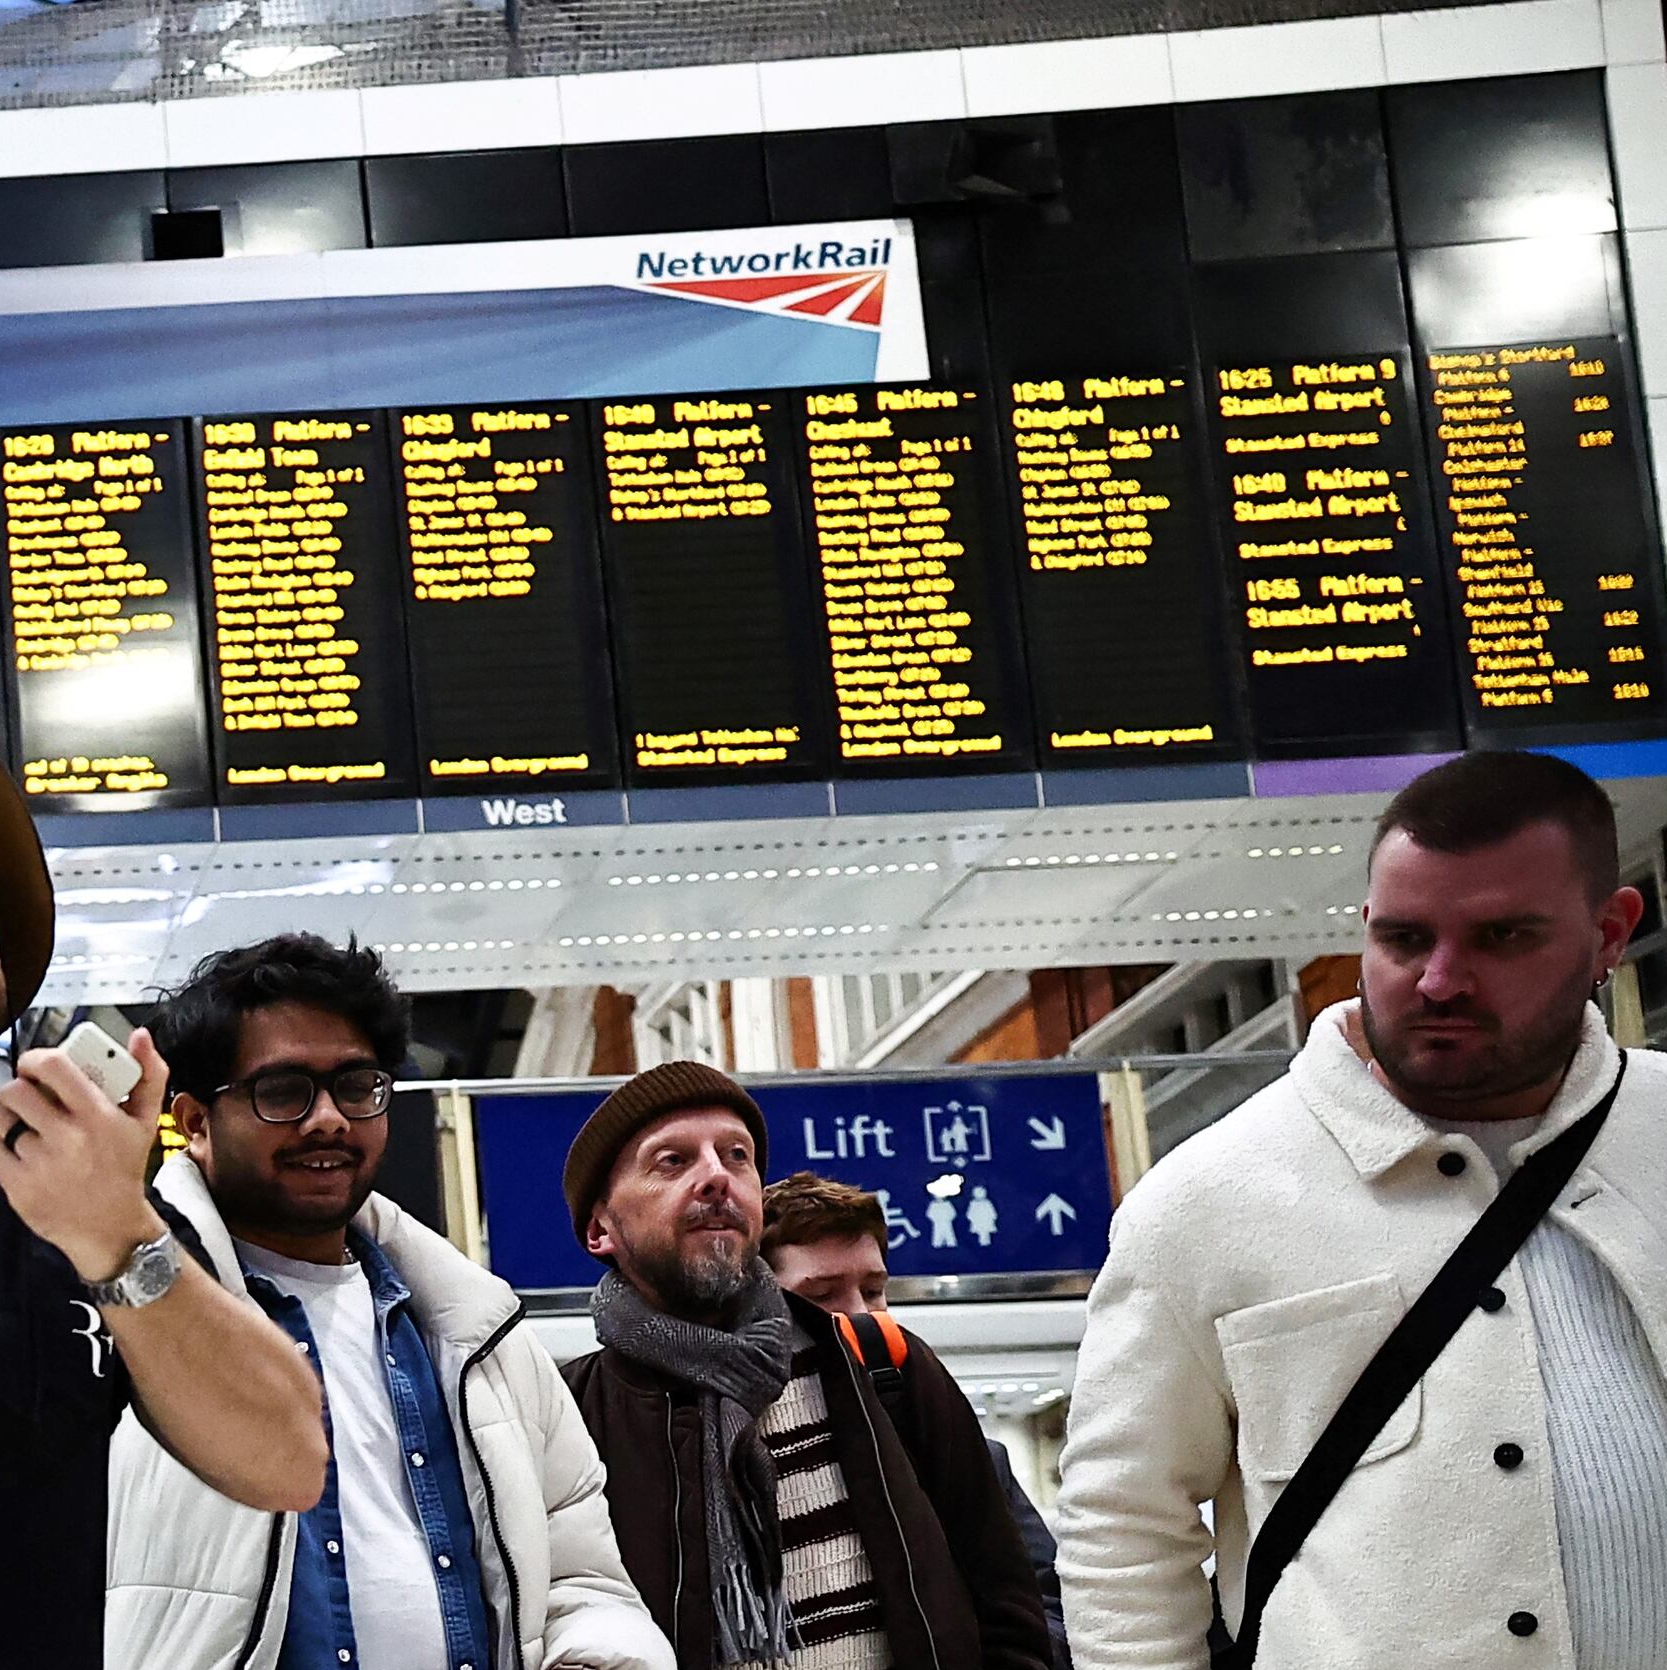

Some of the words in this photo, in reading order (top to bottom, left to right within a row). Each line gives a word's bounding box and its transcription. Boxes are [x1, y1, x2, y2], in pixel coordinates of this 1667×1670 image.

[1084, 377, 1165, 398] Platform
[1220, 368, 1272, 390] 16:25
[1293, 363, 1375, 385] Platform
[877, 389, 957, 410] Platform
[1220, 392, 1309, 416] Stansted
[1314, 387, 1385, 411] Airport
[472, 411, 550, 431] Platform
[674, 400, 752, 422] Platform
[274, 420, 352, 441] Platform
[72, 431, 150, 453] Platform
[1226, 435, 1305, 453] Stansted
[1308, 432, 1379, 448] Express
[1234, 473, 1286, 494] 16:40
[1306, 468, 1389, 490] Platform
[1234, 496, 1323, 521] Stansted
[1328, 492, 1401, 516] Airport
[1239, 540, 1319, 558] Stansted
[1322, 538, 1392, 554] Express
[1248, 579, 1300, 601] 16:55
[1321, 574, 1403, 596] Platform
[1247, 603, 1337, 628] Stansted
[1342, 599, 1414, 623] Airport
[1253, 646, 1333, 665] Stansted
[1336, 645, 1407, 662] Express
[482, 798, 567, 826] West
[804, 1116, 895, 1160] Lift
